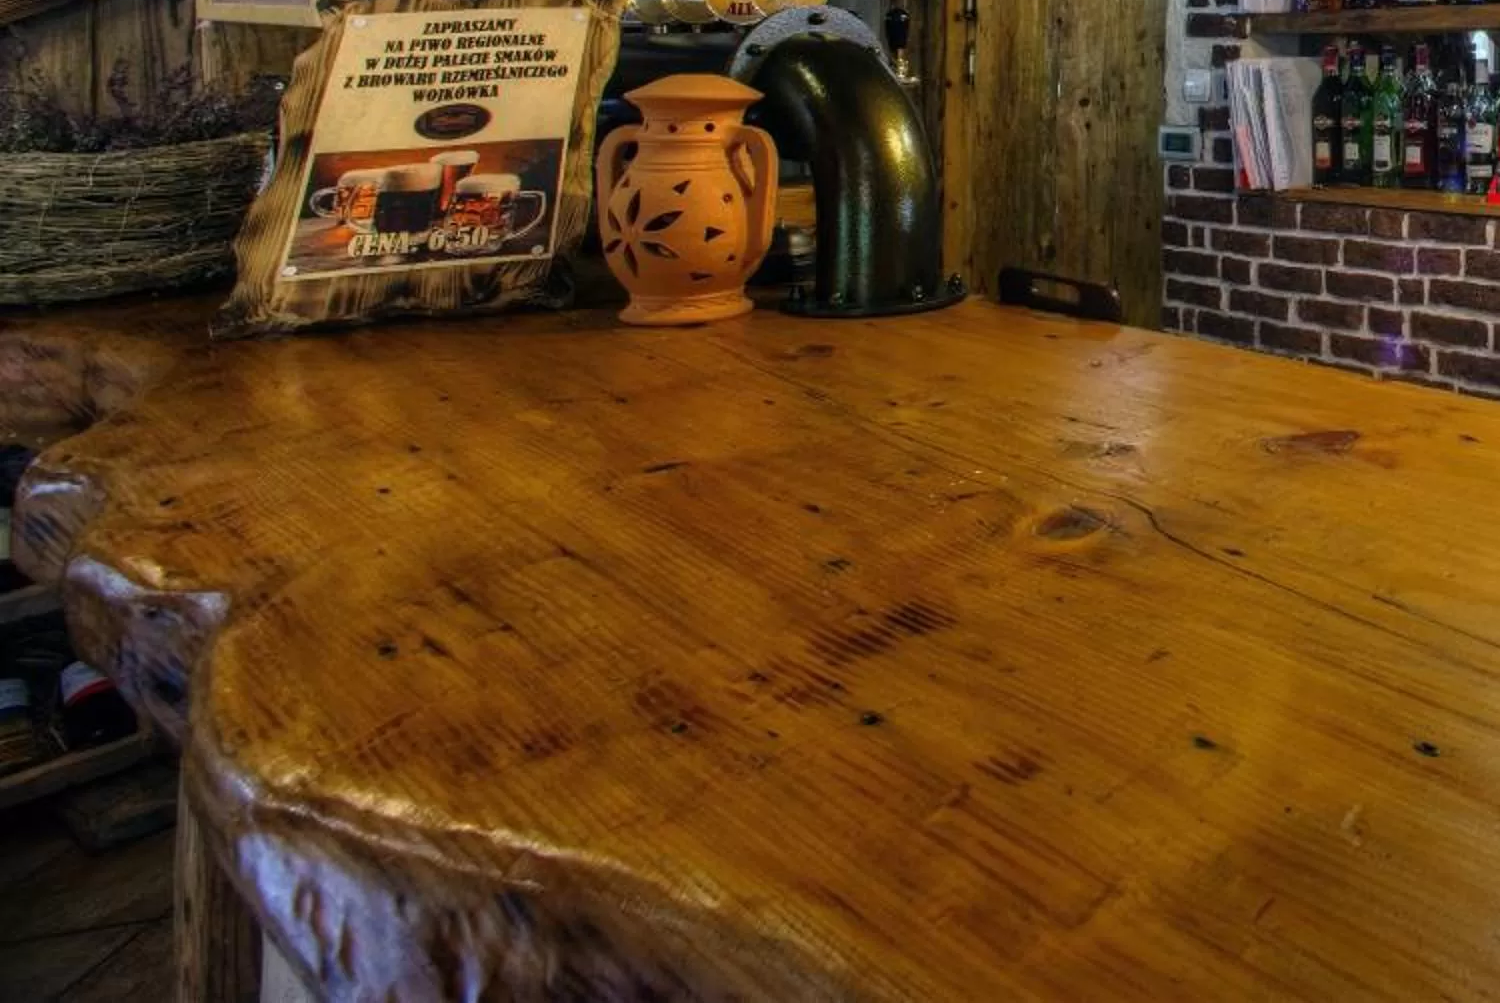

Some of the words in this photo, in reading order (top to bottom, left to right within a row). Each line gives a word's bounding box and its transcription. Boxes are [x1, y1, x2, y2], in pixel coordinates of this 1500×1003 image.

[422, 19, 517, 35] ZAPRASZAMY
[385, 40, 404, 54] NA
[409, 37, 451, 52] PIWO
[456, 34, 545, 49] REGIONALNE
[365, 57, 381, 71] W
[383, 53, 428, 70] DUŻEJ
[432, 51, 491, 68] PALECIE
[493, 48, 558, 64] SMAKÓW
[343, 76, 354, 89] Z
[357, 71, 437, 88] BROWARU
